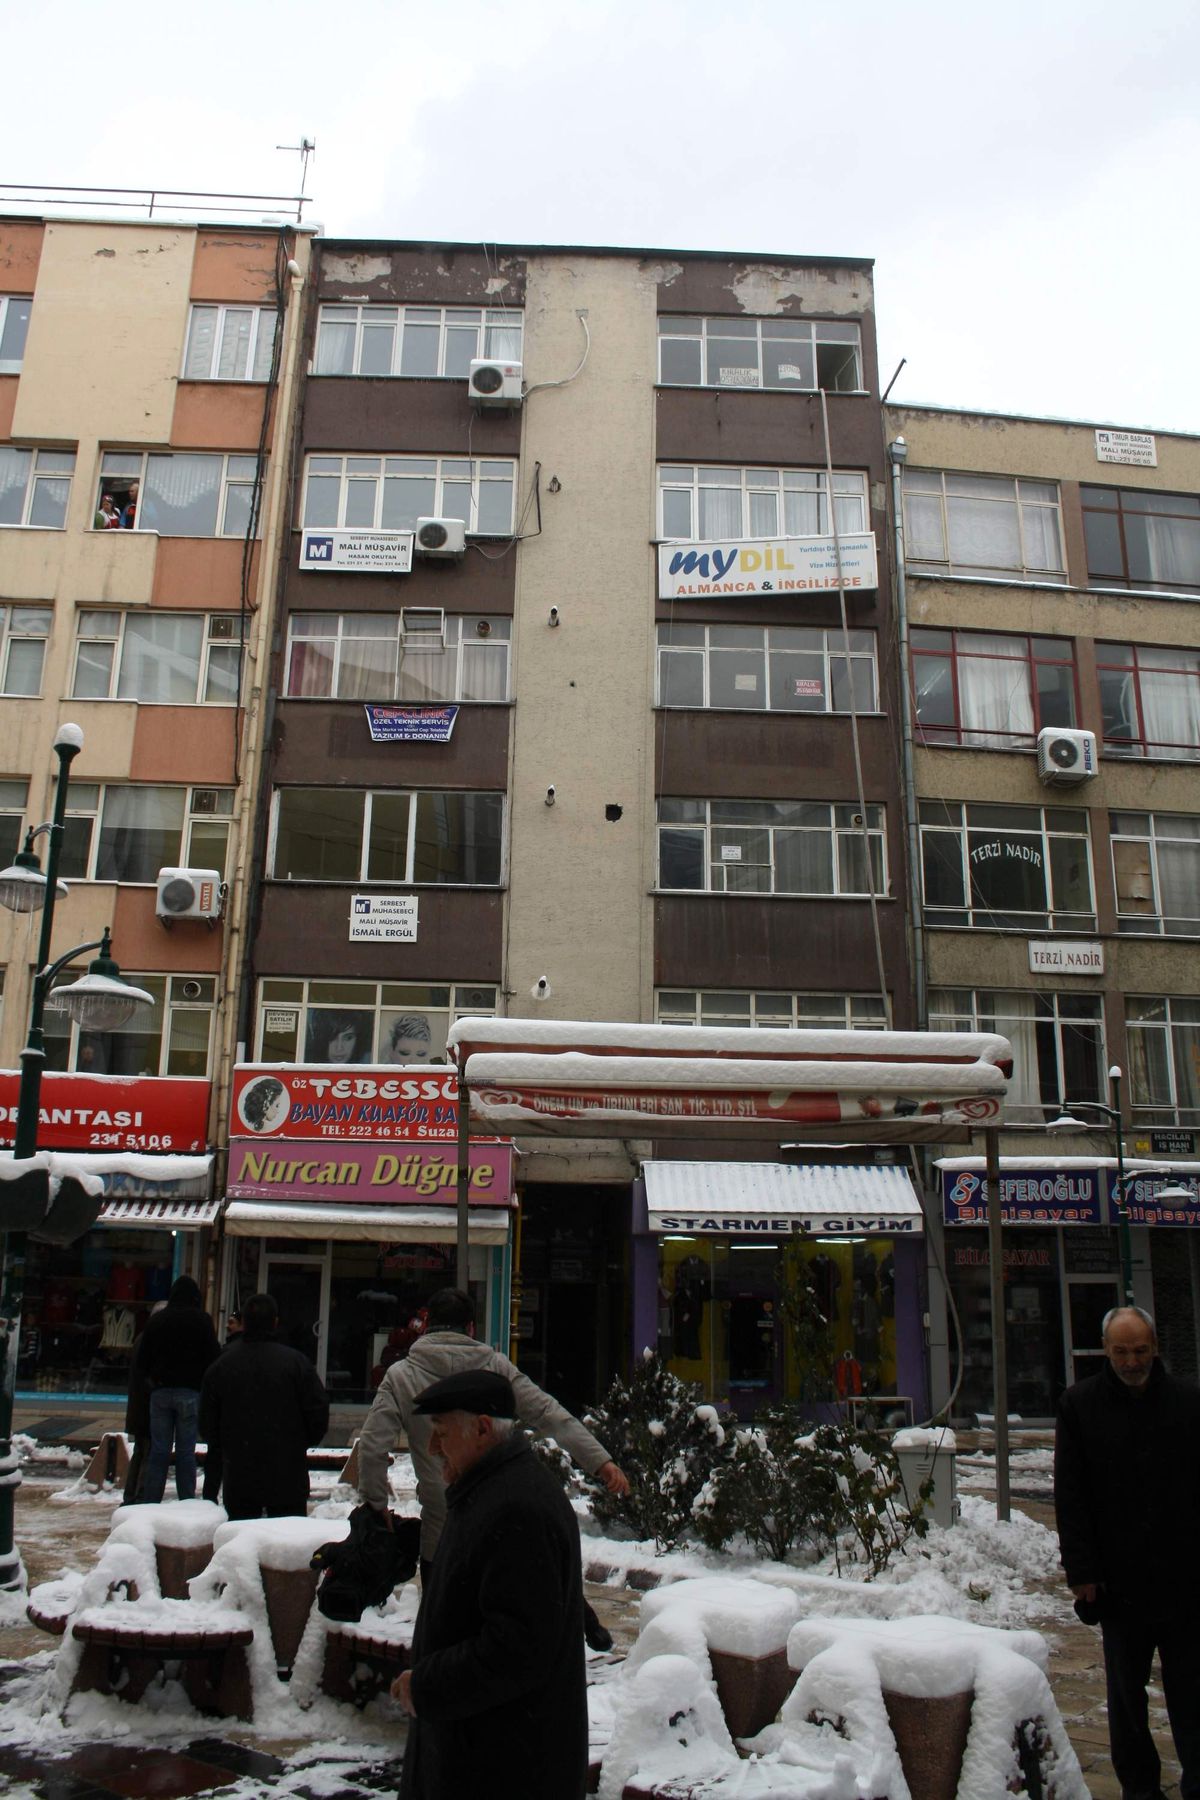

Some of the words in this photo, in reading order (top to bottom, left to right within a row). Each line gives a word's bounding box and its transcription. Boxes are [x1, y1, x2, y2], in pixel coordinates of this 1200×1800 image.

[364, 543, 407, 552] MÜŞAVİR
[677, 582, 757, 595] ALMANCA
[761, 581, 774, 591] &
[778, 576, 862, 590] İNGİLİZCE
[1083, 738, 1092, 770] BEKO
[970, 839, 1002, 864] TERZİ
[1005, 843, 1042, 868] NADİR
[352, 927, 382, 936] İSMAİL
[385, 929, 414, 937] ERGÜL
[1033, 950, 1063, 964] TERZİ
[1067, 950, 1101, 966] NADİR
[292, 1077, 307, 1089] ÖZ
[308, 1075, 459, 1100] TEBESSÜ
[290, 1104, 354, 1124] BAYAN
[358, 1101, 430, 1124] KUAFÖR
[660, 1098, 686, 1115] SAN.
[688, 1096, 709, 1115] TİC.
[712, 1099, 735, 1115] LTD.
[126, 1134, 173, 1147] 5106
[321, 1125, 345, 1136] TEL:
[349, 1125, 372, 1136] 222
[376, 1126, 391, 1136] 46
[395, 1126, 409, 1137] 54
[417, 1125, 459, 1137] Suza
[238, 1152, 361, 1185] Nurcan
[661, 1218, 812, 1231] STARMEN
[823, 1217, 913, 1231] GİYİM
